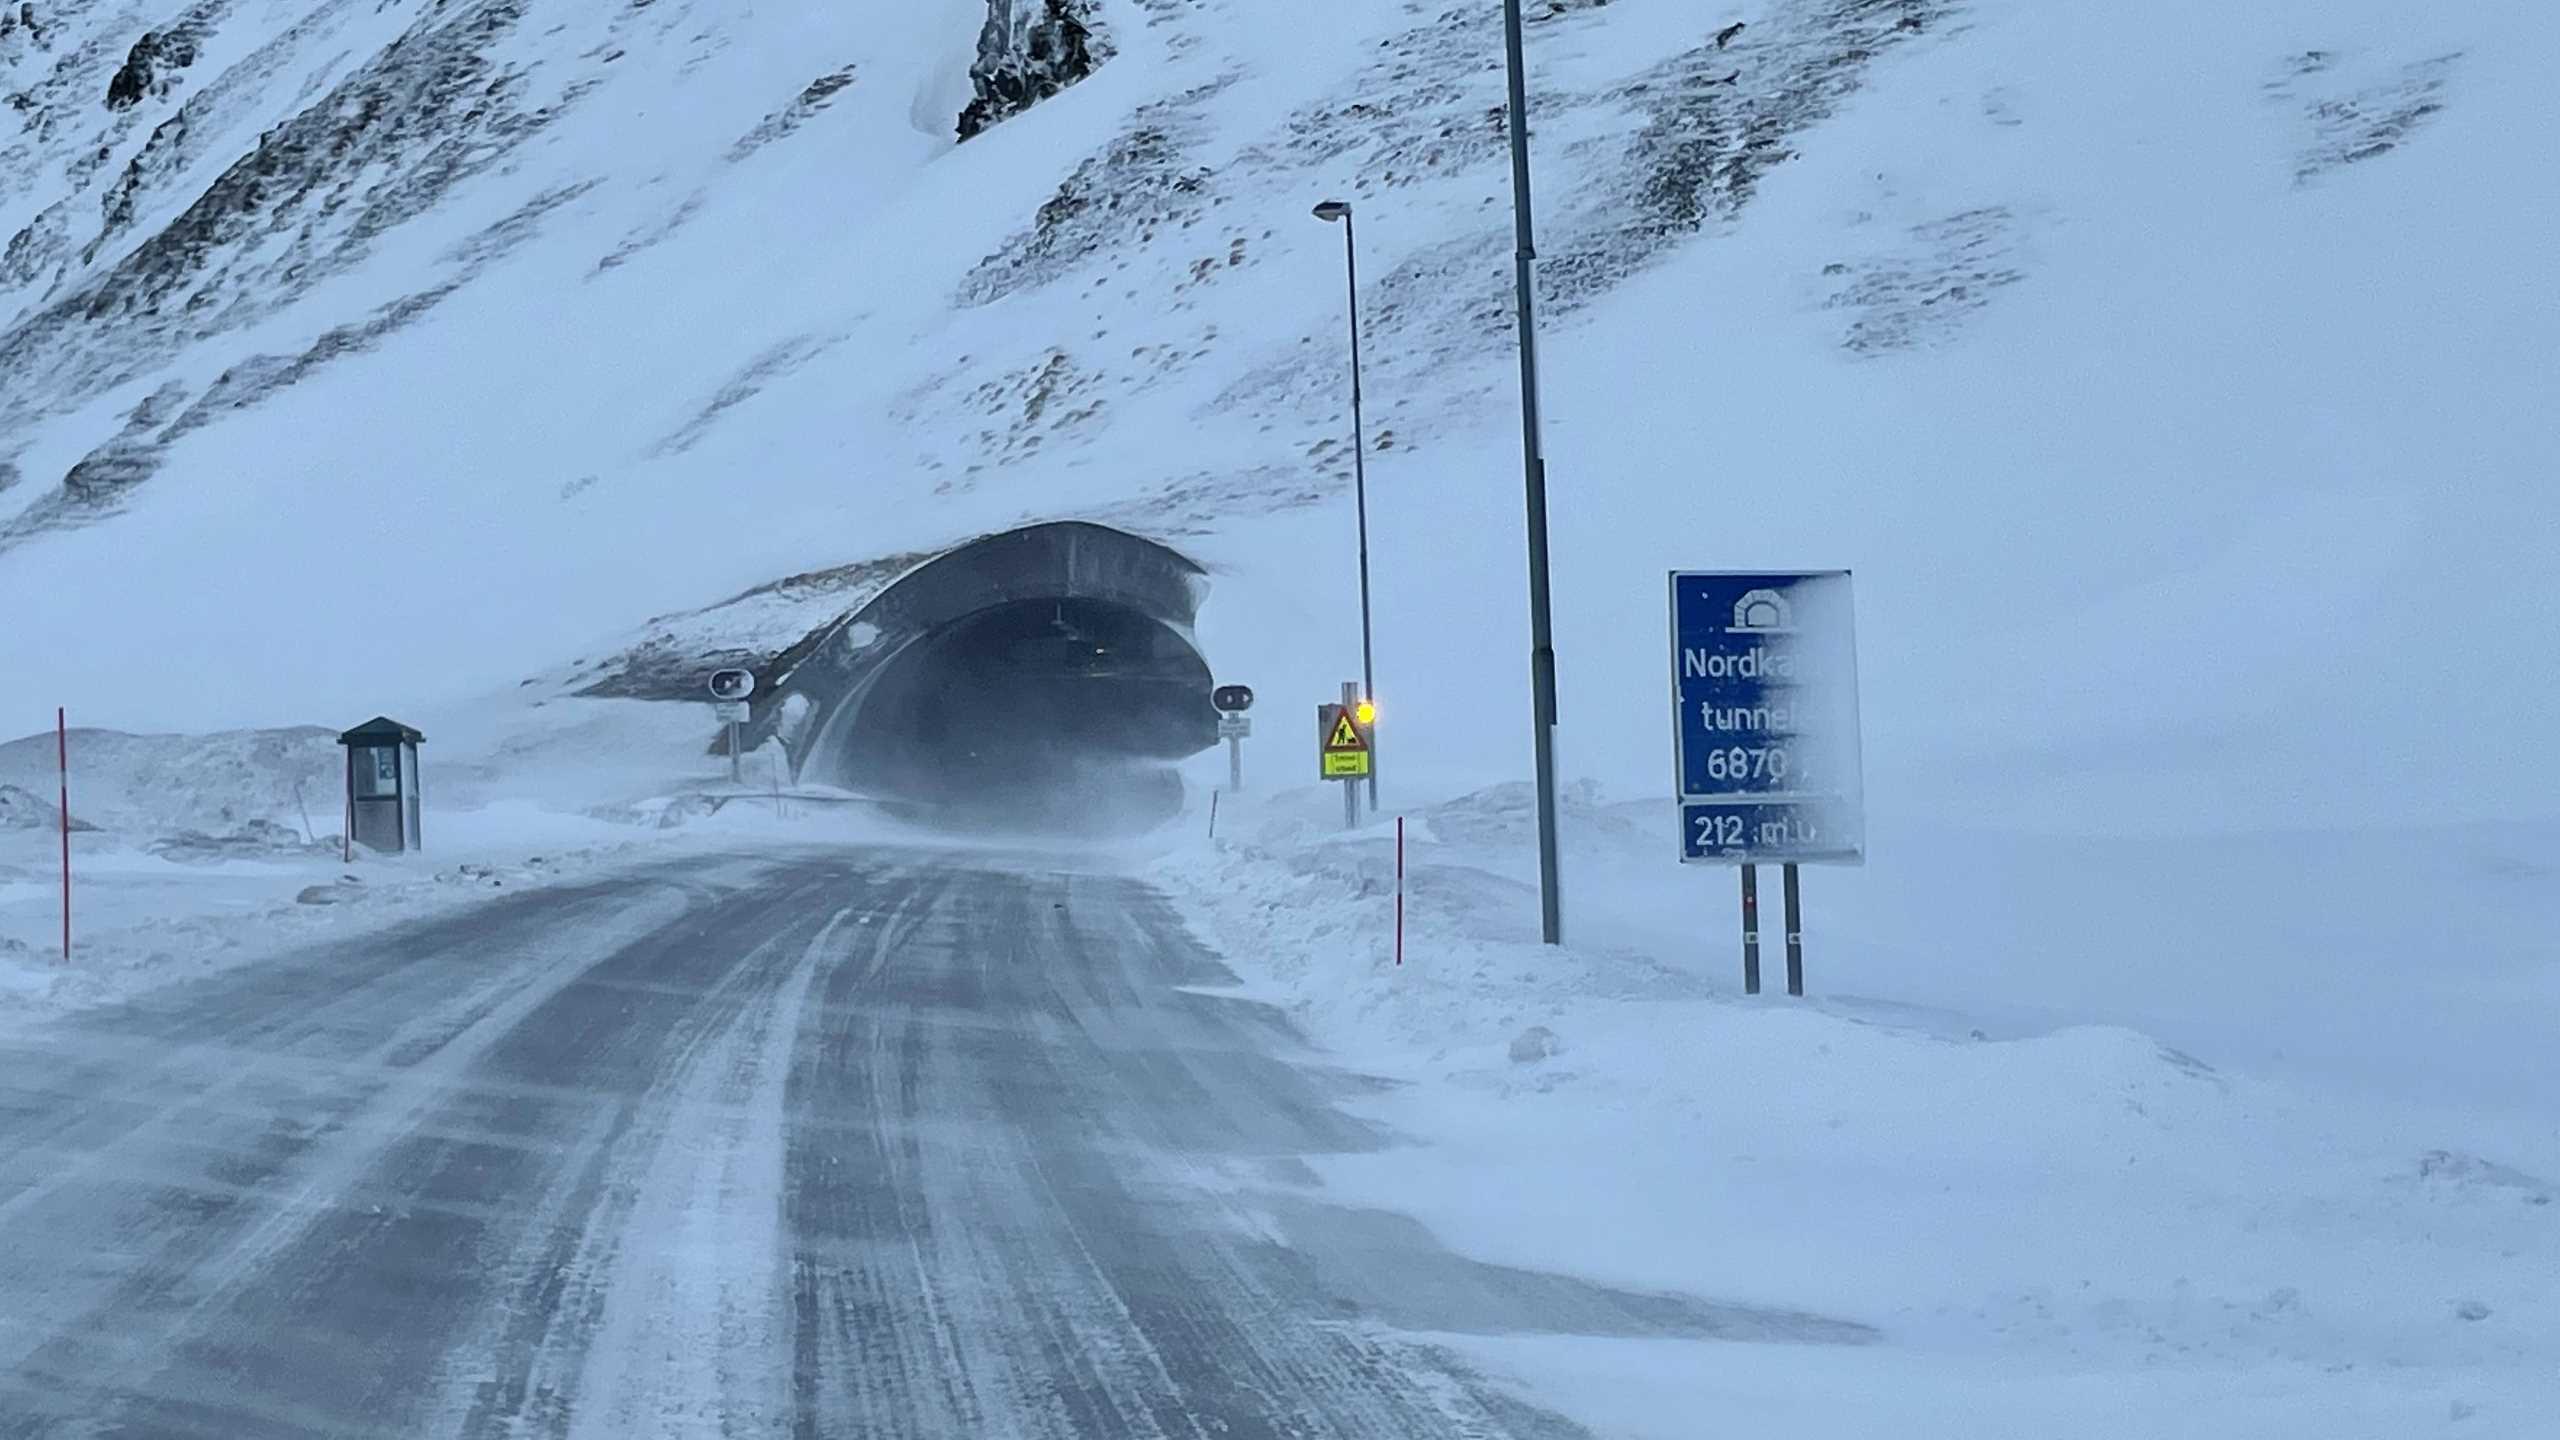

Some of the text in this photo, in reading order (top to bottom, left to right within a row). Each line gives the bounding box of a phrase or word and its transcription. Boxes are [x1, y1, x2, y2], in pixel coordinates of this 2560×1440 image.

[1684, 648, 1796, 678] Nordka
[1702, 702, 1796, 730] tunnel
[1707, 750, 1786, 779] 6870
[1695, 815, 1744, 846] 212
